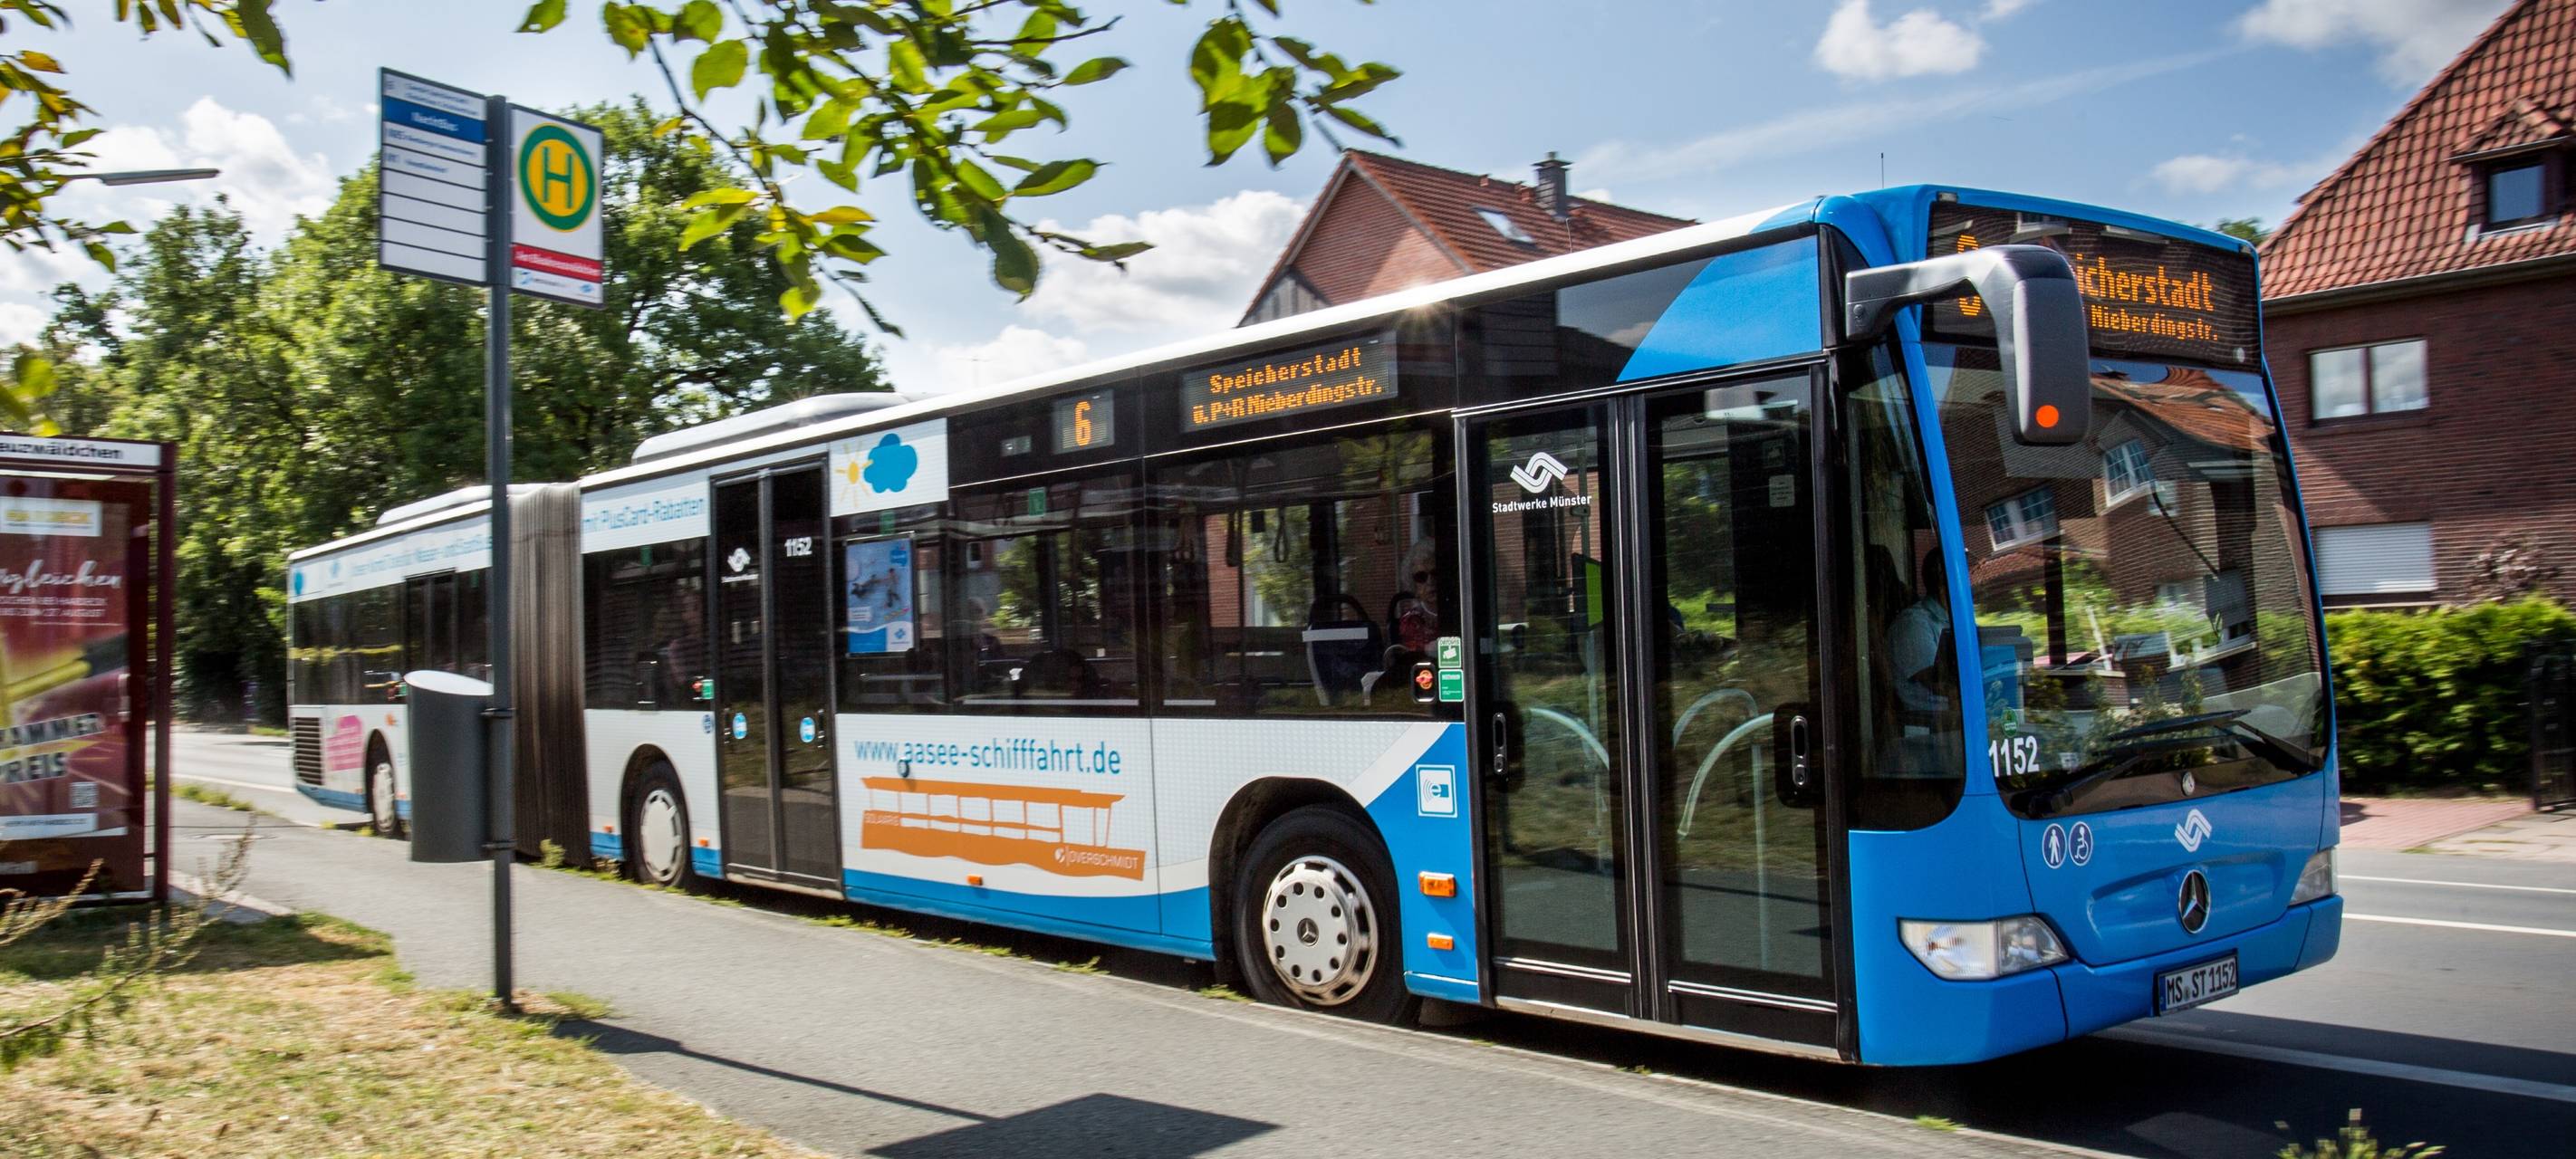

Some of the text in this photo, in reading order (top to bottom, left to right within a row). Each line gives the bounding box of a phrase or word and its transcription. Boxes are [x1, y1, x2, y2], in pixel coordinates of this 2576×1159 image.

[542, 146, 573, 209] H
[2073, 253, 2215, 311] icherstadt
[2091, 304, 2218, 340] Nieberdingstr.
[1209, 347, 1361, 395] Speicherstadt
[1246, 376, 1382, 415] Nieberdingstr.
[1074, 400, 1091, 446] 6
[1492, 494, 1592, 513] Stadtwerke Münster
[784, 536, 812, 558] 1152
[0, 713, 102, 750] AMMER
[0, 752, 68, 783] REIS
[854, 738, 1122, 774] wwwaasee-schifffahrt.de
[1988, 735, 2040, 778] 1152
[1067, 848, 1139, 870] OVERSCHMIDT
[2166, 962, 2236, 1005] MS ST 1152
